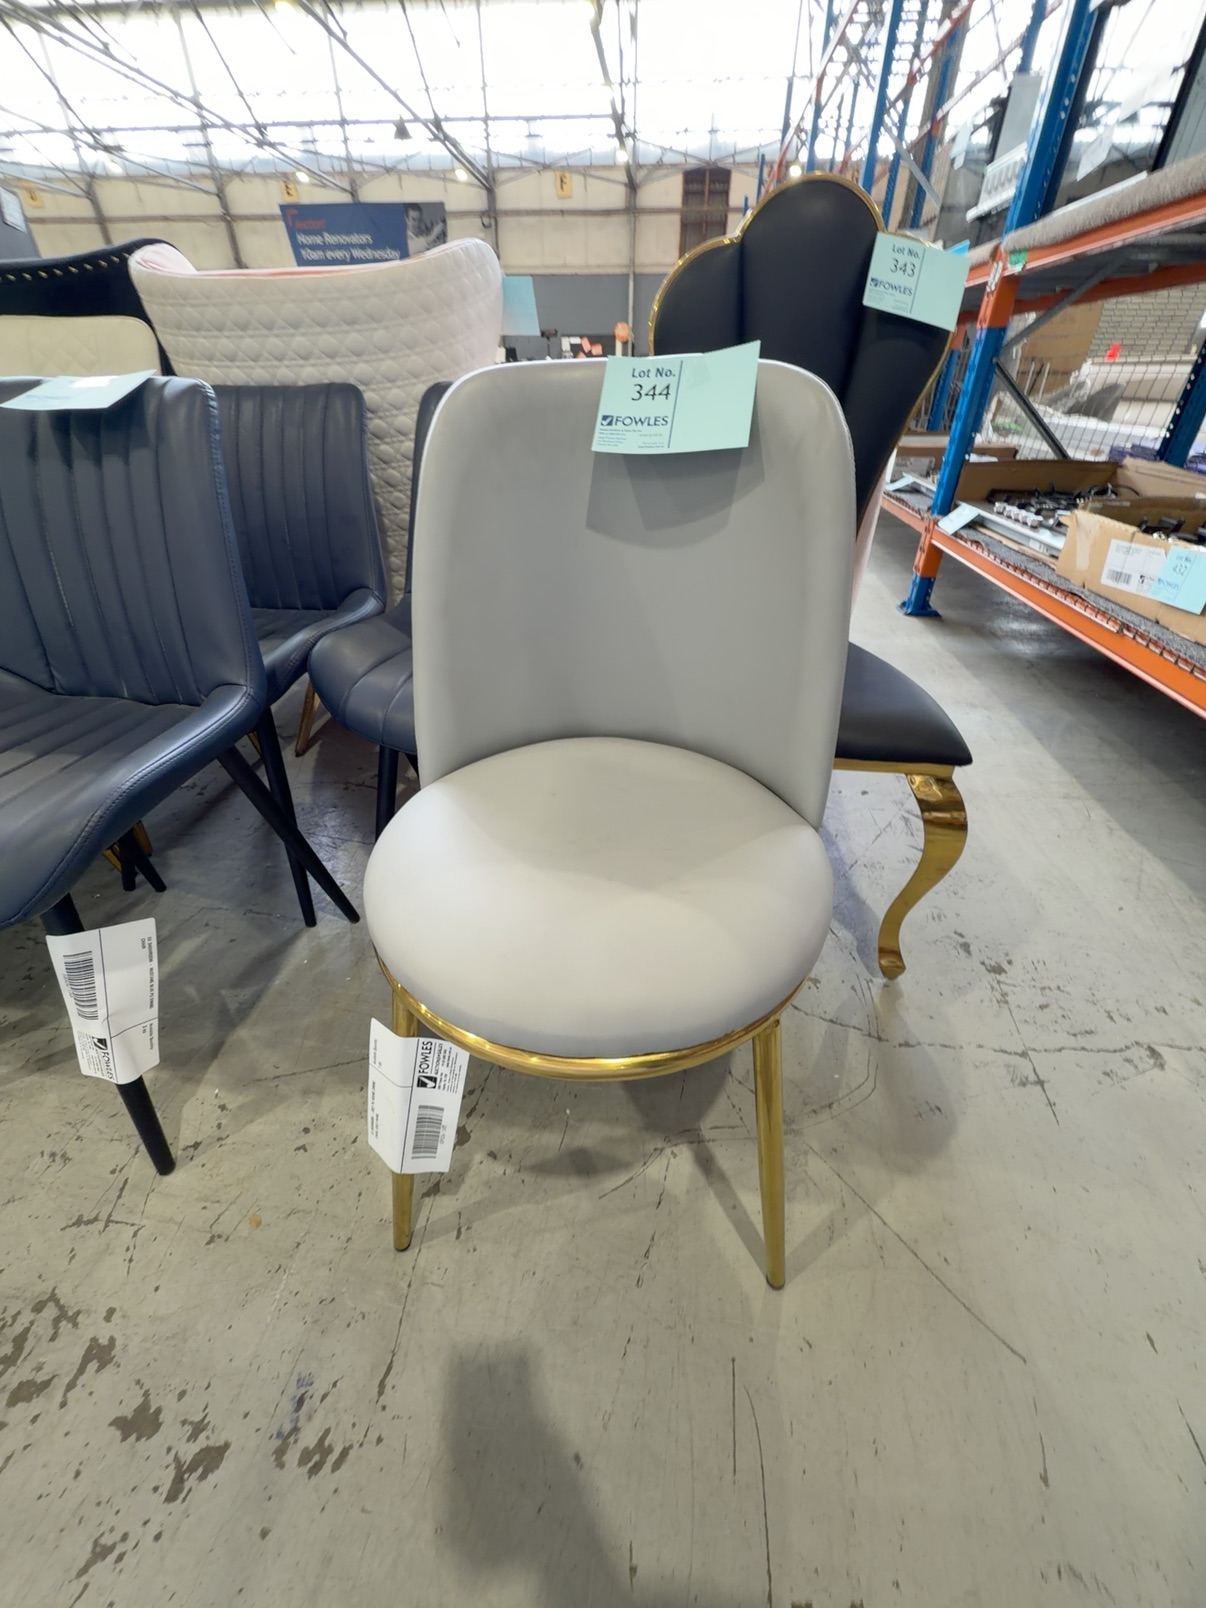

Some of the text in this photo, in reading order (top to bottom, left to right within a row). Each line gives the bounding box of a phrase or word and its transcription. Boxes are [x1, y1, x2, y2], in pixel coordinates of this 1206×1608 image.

[297, 231, 373, 245] Home Renovators
[326, 249, 350, 263] every
[350, 247, 399, 261] Wednesday
[892, 243, 921, 260] Lot No.
[890, 258, 916, 278] 343
[878, 281, 913, 296] FOWLES
[632, 367, 676, 379] Lot No.
[631, 383, 671, 402] 344
[614, 415, 669, 427] FOWLES
[101, 1051, 114, 1080] FOWLES
[419, 1041, 432, 1074] FOWLES
